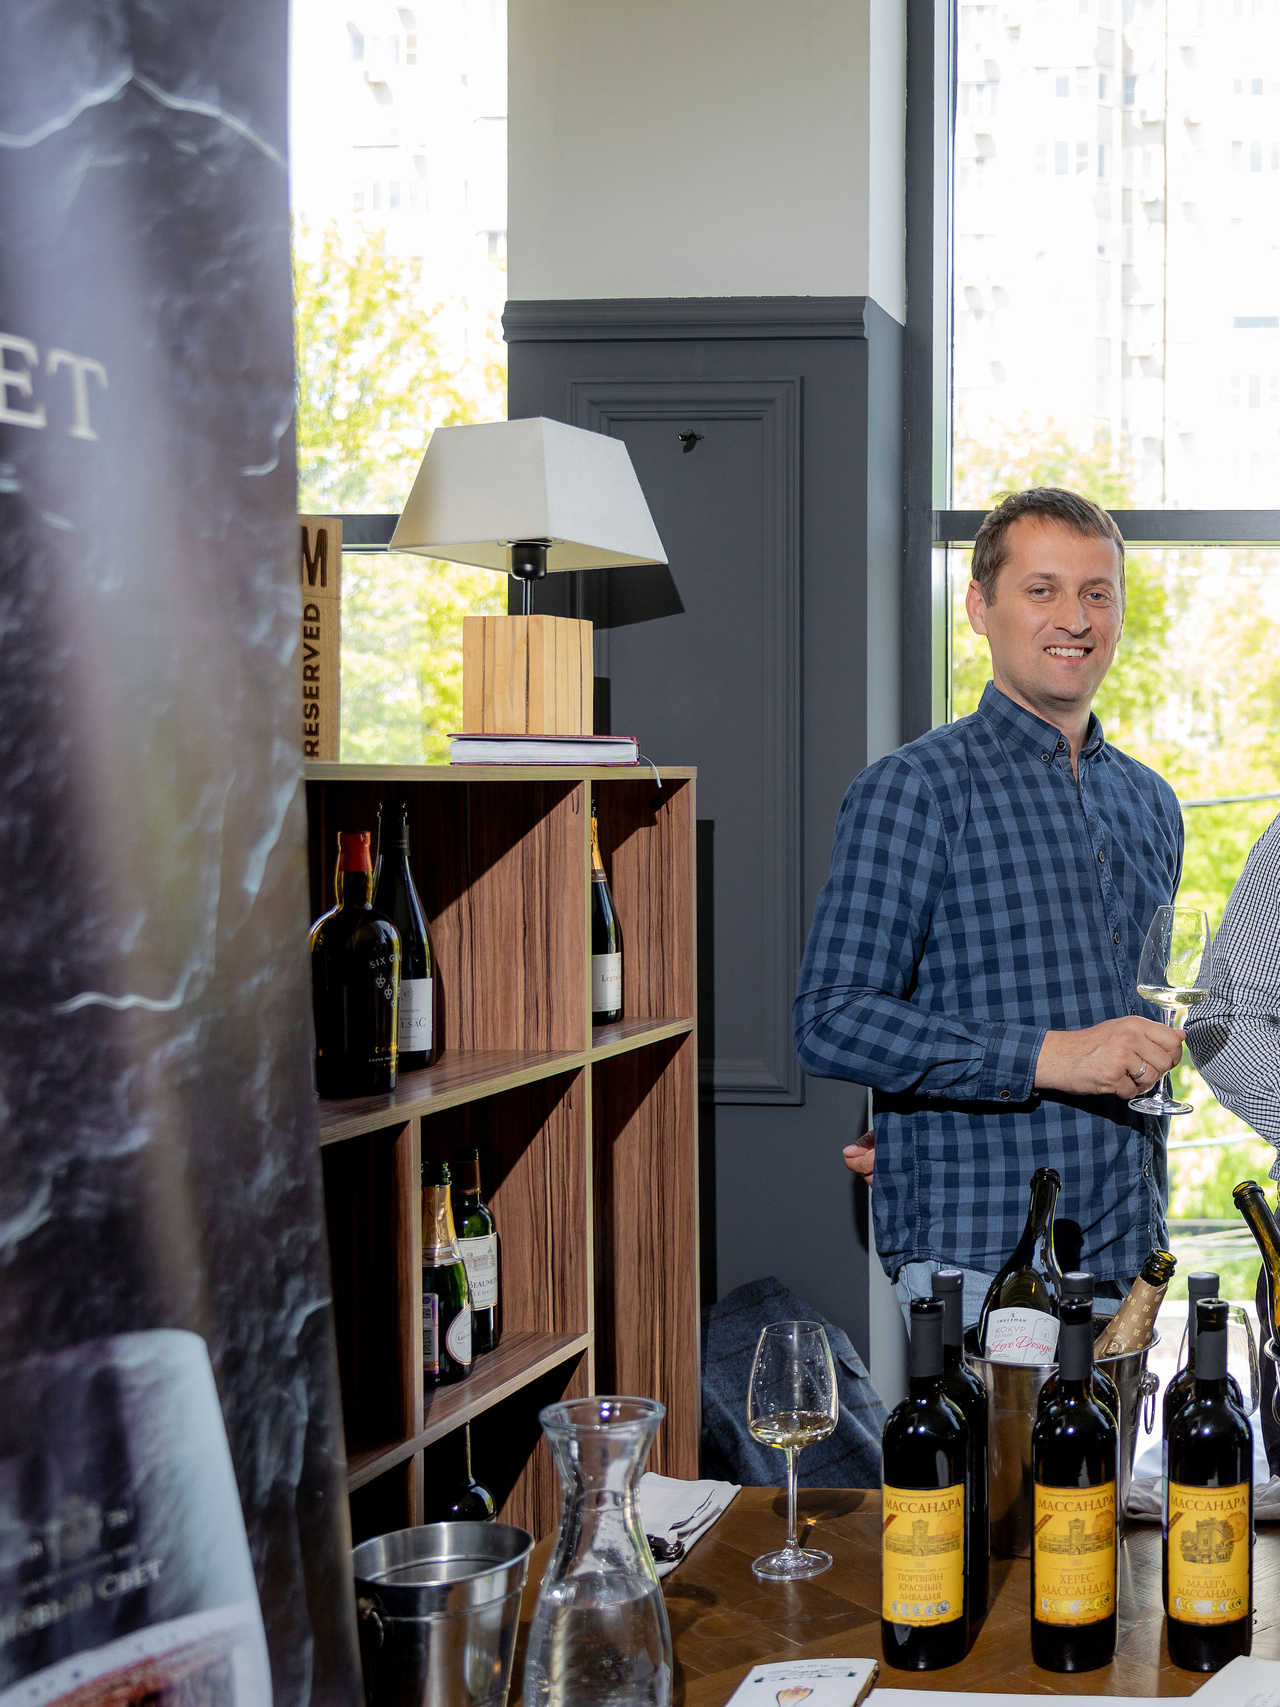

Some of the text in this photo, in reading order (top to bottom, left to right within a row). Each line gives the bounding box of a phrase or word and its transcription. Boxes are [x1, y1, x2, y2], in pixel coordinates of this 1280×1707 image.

[303, 603, 321, 758] RESERVED
[369, 956, 386, 969] SIX
[990, 1335, 1053, 1355] Zero Dosage
[885, 1497, 962, 1513] МАССАНДРА
[1037, 1494, 1114, 1513] МАССАНДРА
[1170, 1495, 1247, 1511] МАССАНДРА
[898, 1573, 944, 1582] ПОРТВЕЙН
[1060, 1573, 1095, 1584] ХЕРЕС
[1187, 1579, 1227, 1589] МАДЕРА
[899, 1582, 942, 1592] КРАСНЫЙ
[1042, 1580, 1111, 1596] МАССАНДРА
[1177, 1586, 1238, 1598] МАССАНДРА
[900, 1592, 942, 1601] ЛИВАДИЯ
